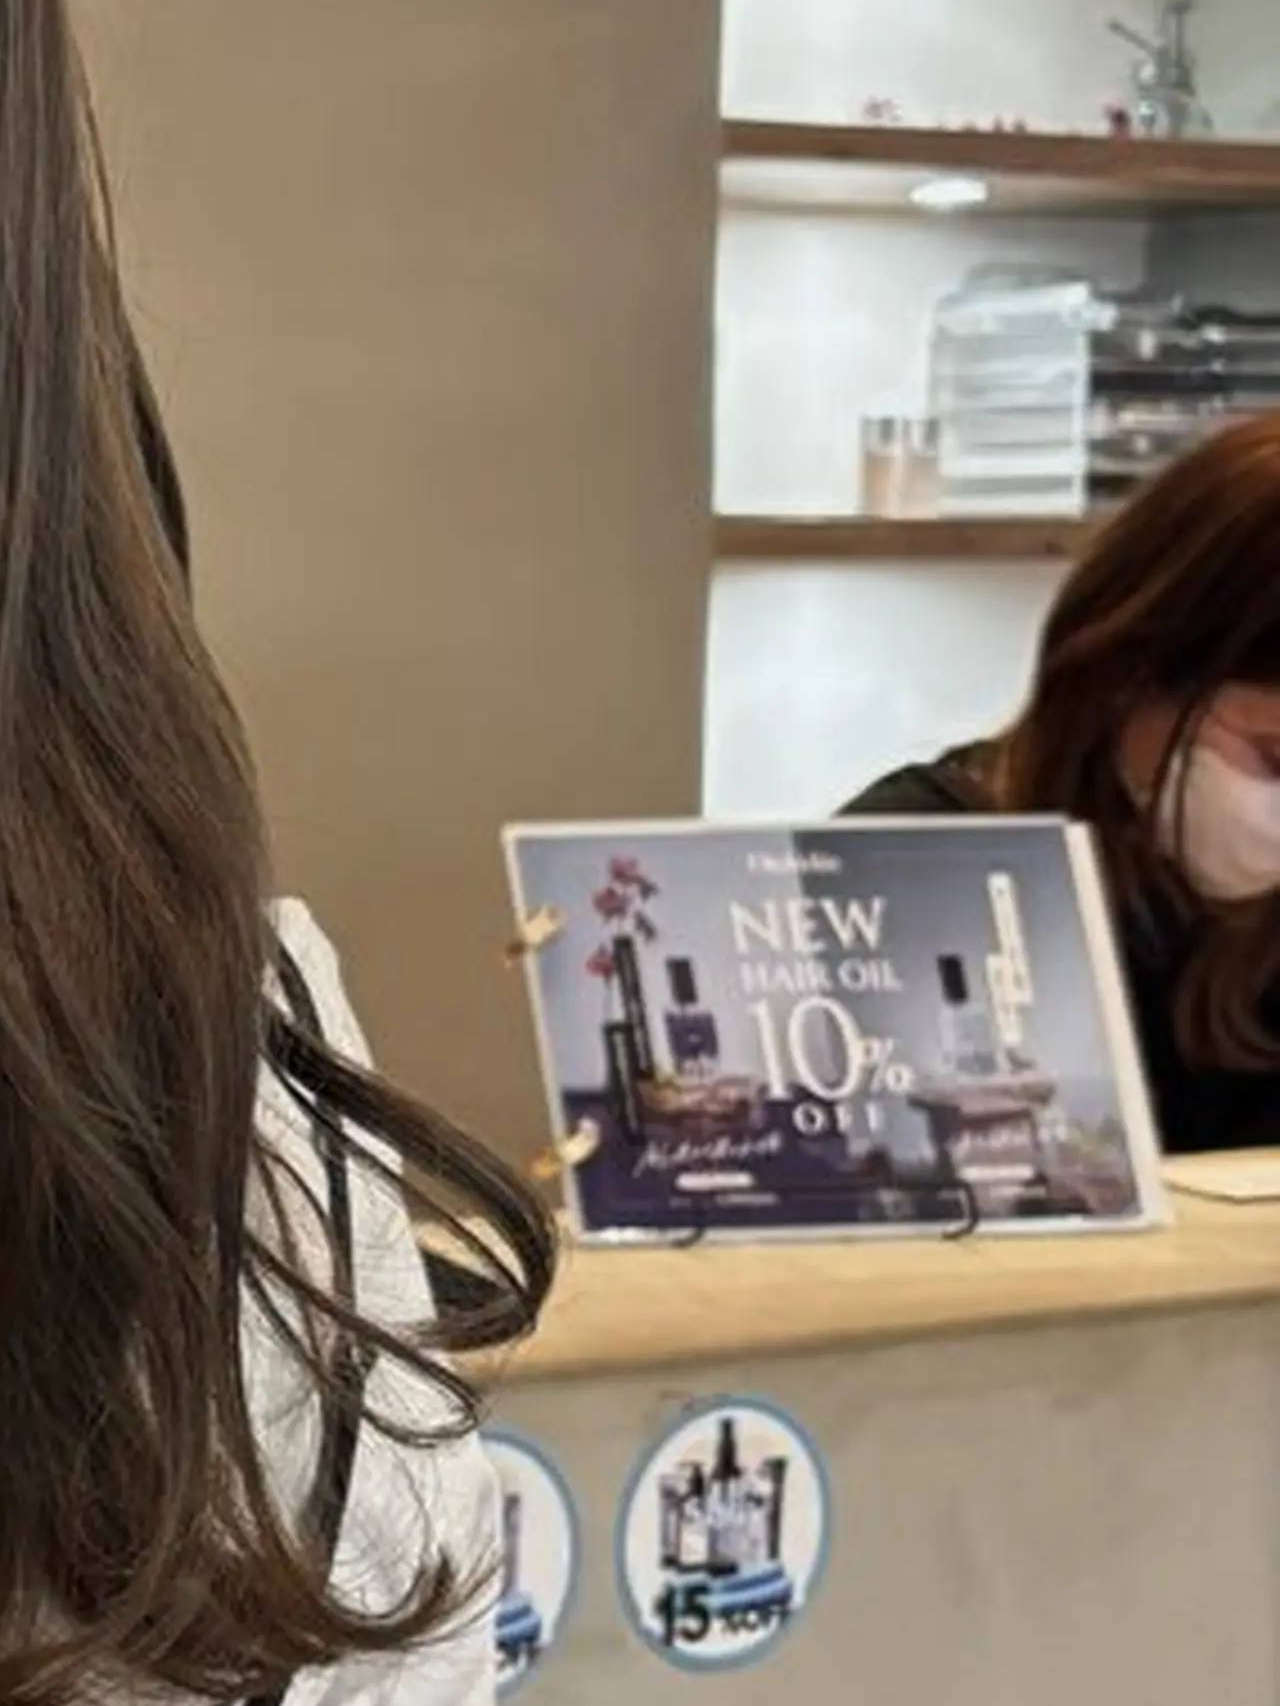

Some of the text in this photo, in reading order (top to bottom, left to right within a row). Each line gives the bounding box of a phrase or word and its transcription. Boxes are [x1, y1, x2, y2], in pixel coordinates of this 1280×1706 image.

[728, 896, 888, 955] NEW
[740, 957, 904, 995] HAIR OIL
